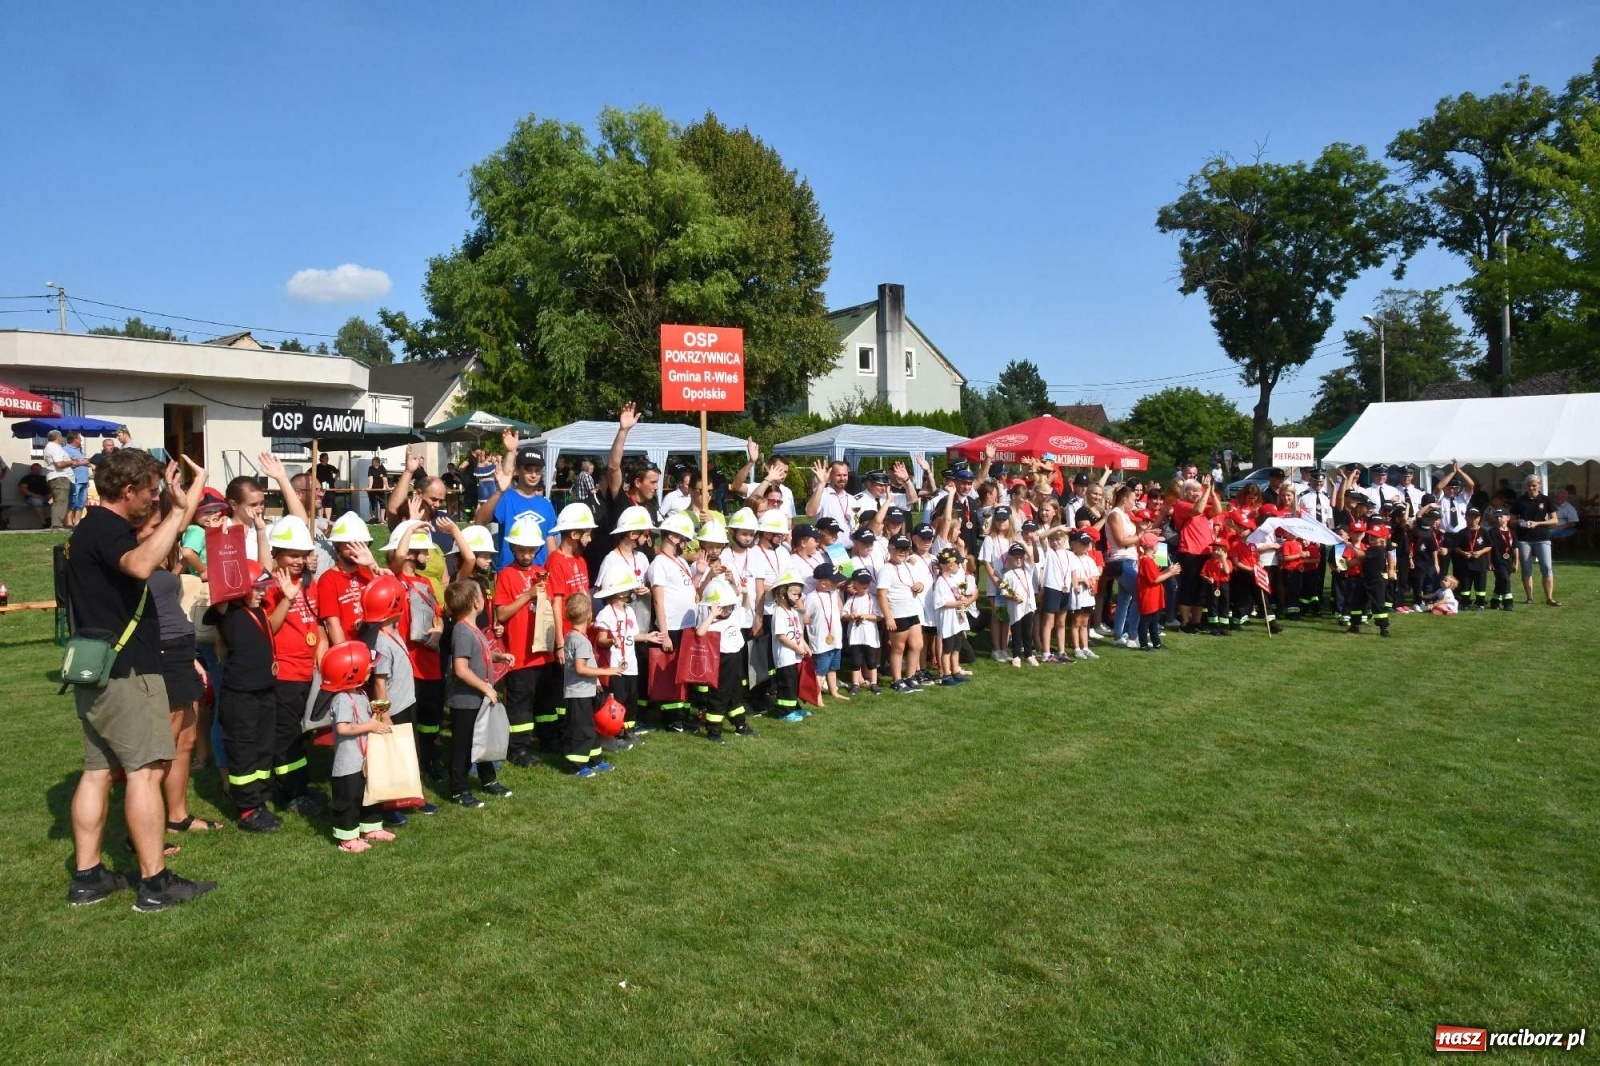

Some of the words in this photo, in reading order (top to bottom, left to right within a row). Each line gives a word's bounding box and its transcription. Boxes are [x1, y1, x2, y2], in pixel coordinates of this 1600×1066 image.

[683, 331, 719, 348] OSP
[665, 349, 741, 366] POKRZYWNICA
[668, 369, 702, 383] Gmina
[703, 370, 739, 384] R-Wieś
[682, 386, 727, 402] Opolskie
[272, 411, 304, 431] OSP
[312, 409, 364, 433] GAMÓW
[1287, 441, 1300, 450] OSP
[1273, 452, 1312, 461] PIETRASZYN
